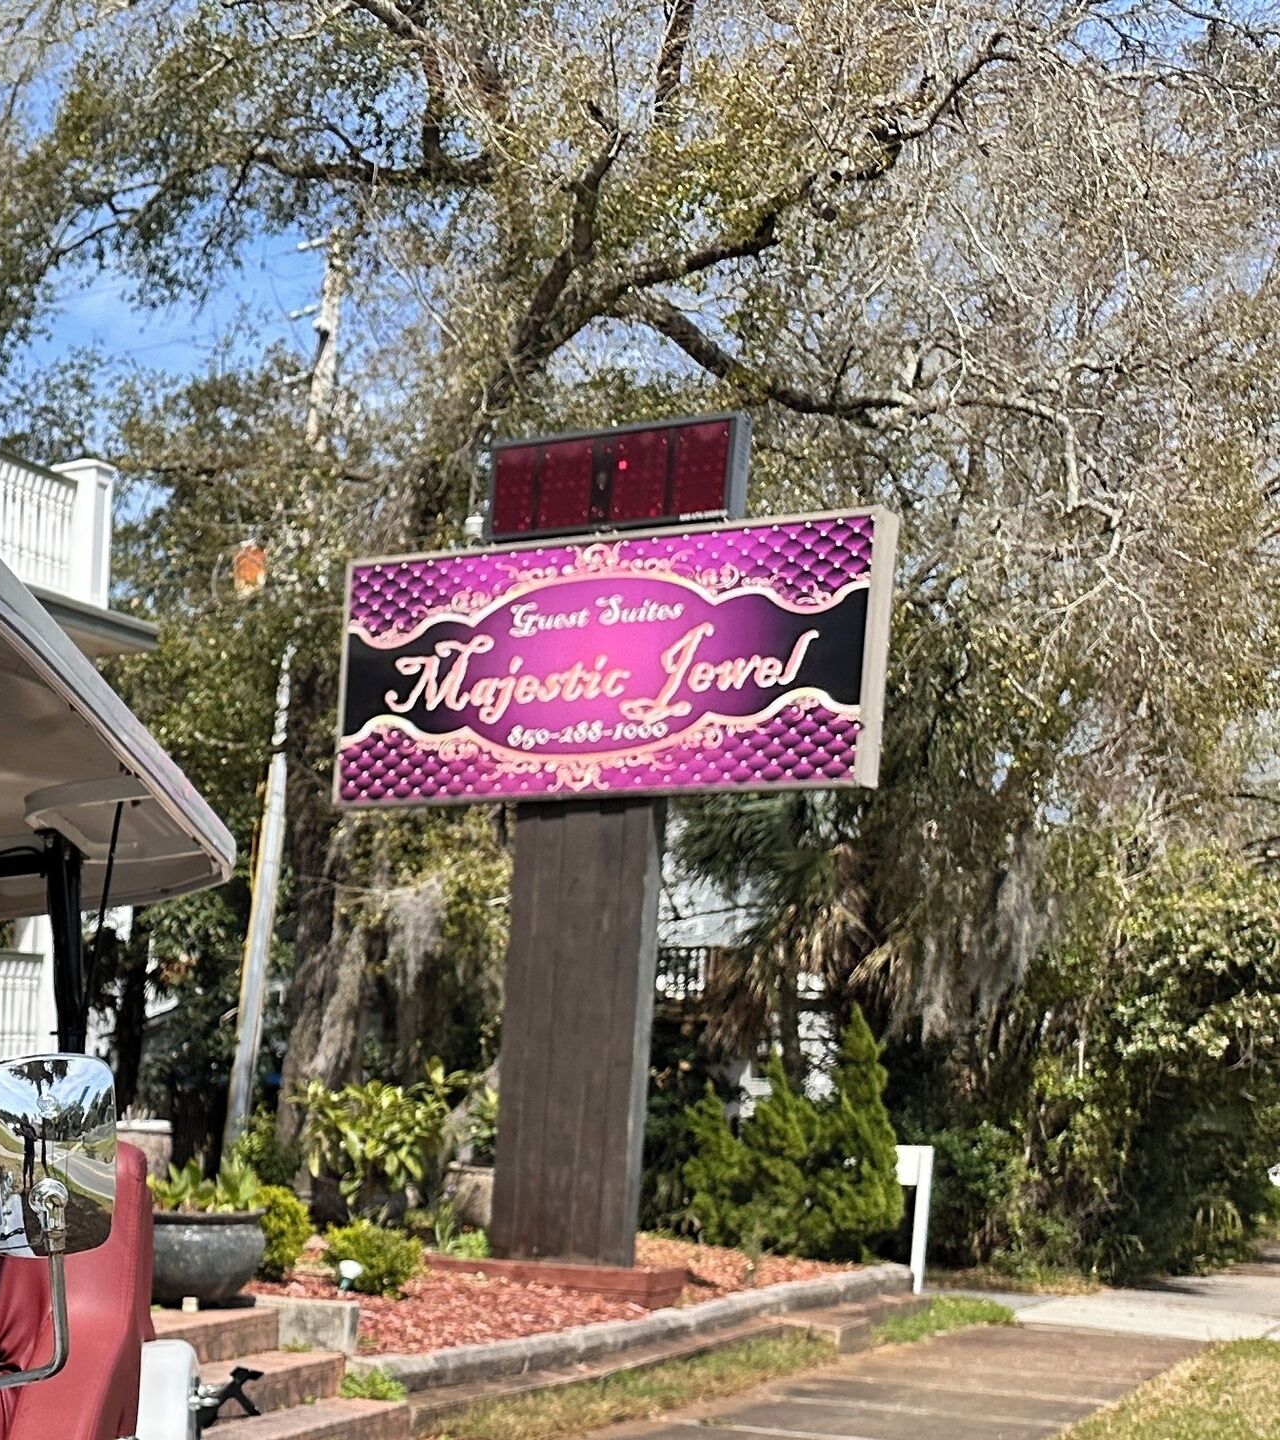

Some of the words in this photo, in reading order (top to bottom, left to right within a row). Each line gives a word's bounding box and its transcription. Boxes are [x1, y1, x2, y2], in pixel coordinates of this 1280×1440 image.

[509, 602, 590, 638] Guest
[595, 594, 686, 626] Suites
[385, 635, 630, 724] Majestic
[620, 623, 820, 719] Jewel
[507, 720, 669, 751] 850-288-1000
